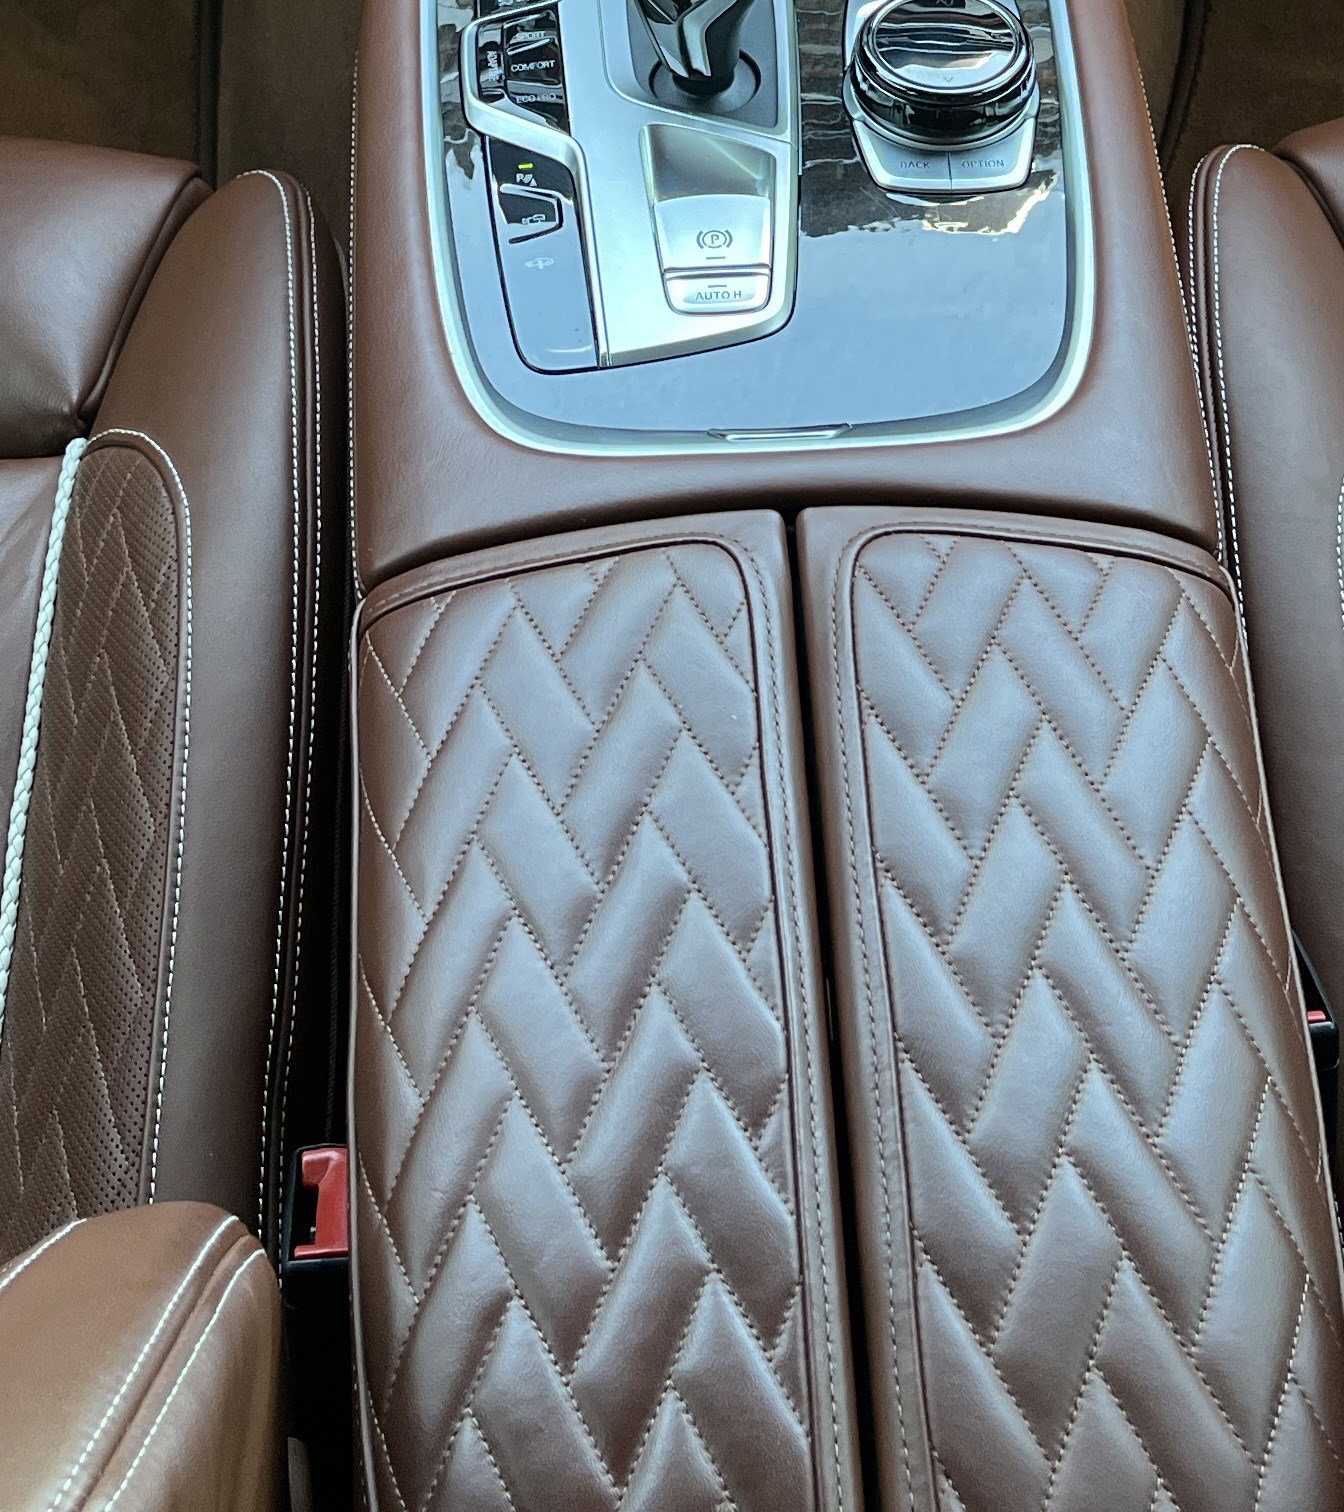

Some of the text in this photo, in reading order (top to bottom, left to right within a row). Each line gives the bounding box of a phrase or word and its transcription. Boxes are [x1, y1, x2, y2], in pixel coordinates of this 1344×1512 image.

[510, 59, 556, 73] COMFORT
[899, 159, 1005, 169] BACK OPTION
[695, 289, 742, 301] AUTO H
